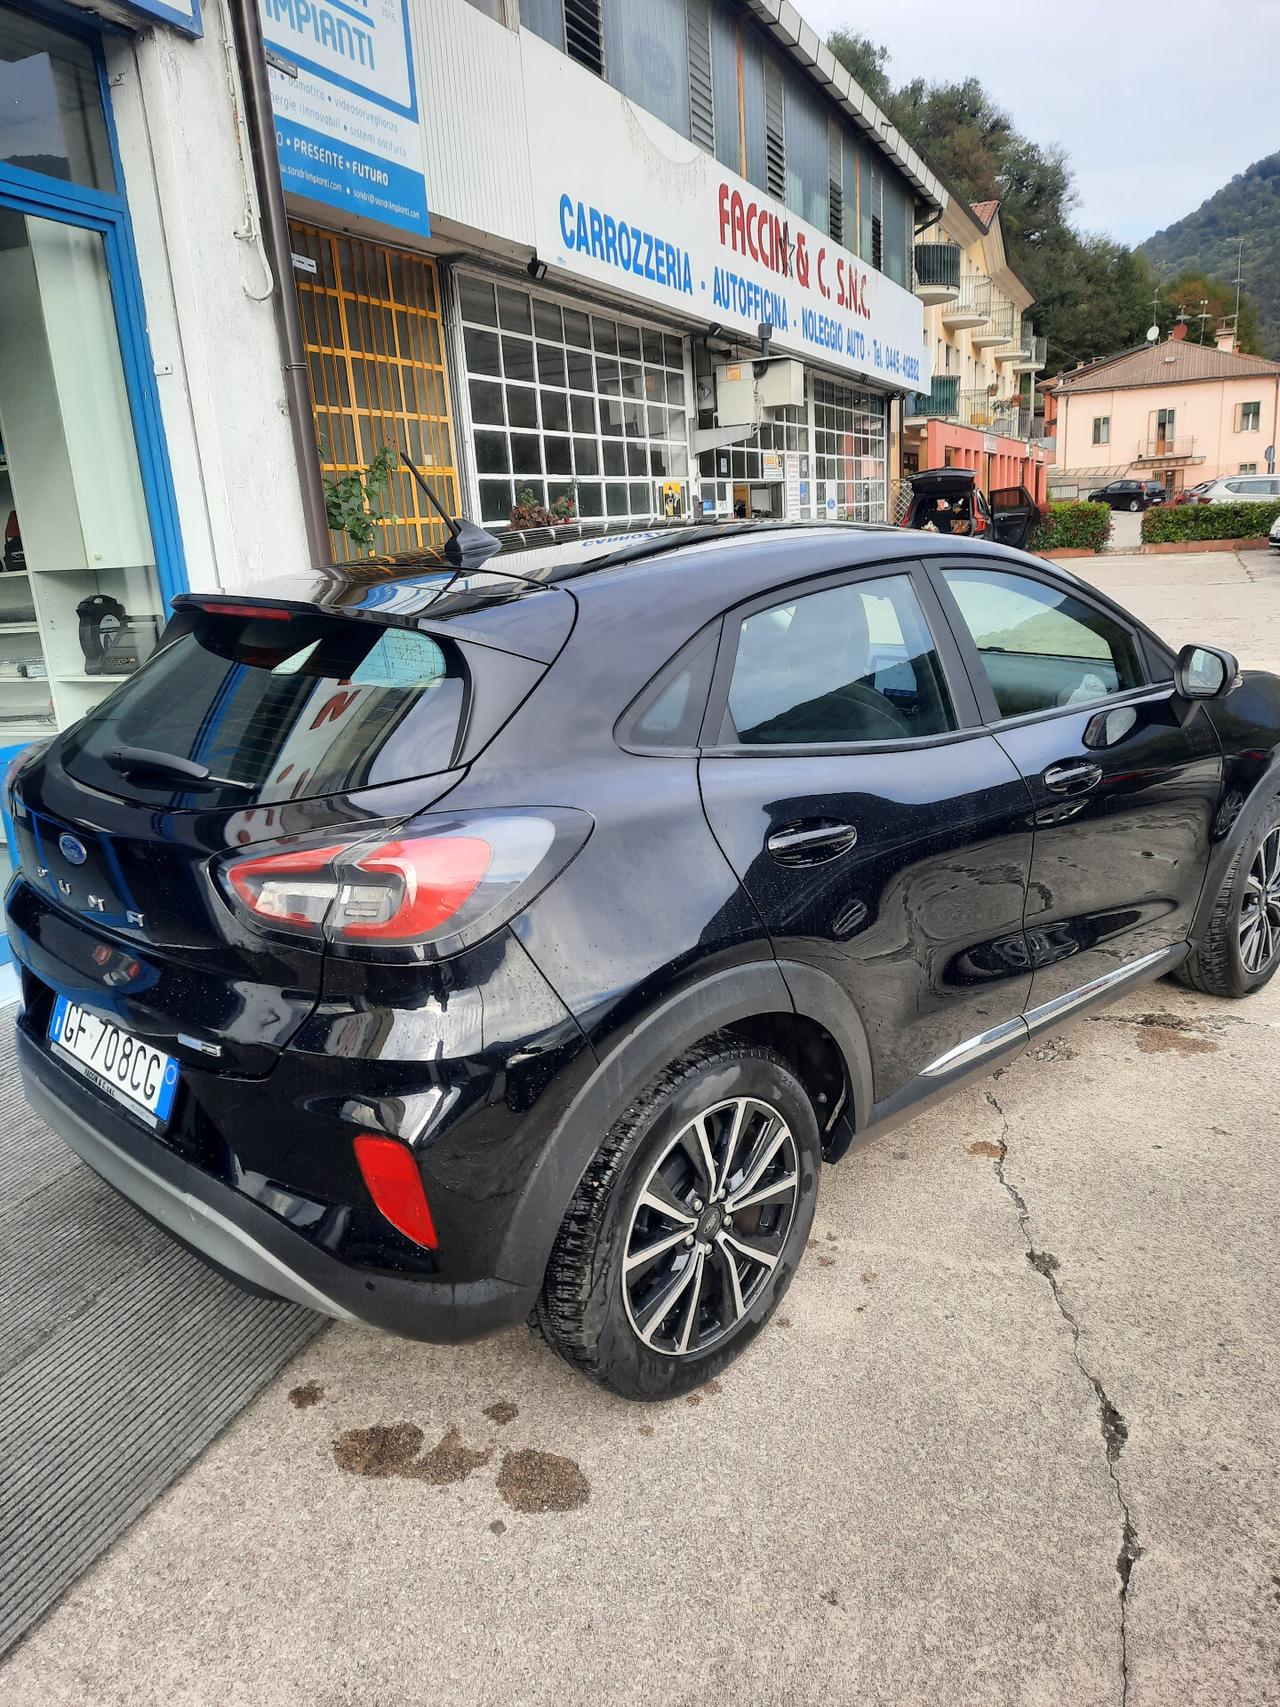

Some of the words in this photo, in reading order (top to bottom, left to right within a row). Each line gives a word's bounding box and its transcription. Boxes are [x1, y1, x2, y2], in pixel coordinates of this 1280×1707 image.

[271, 92, 297, 111] nergie
[349, 125, 376, 144] sistemi
[293, 137, 344, 170] PRESENTE
[352, 160, 389, 187] FUTURO
[560, 193, 693, 295] CARROZZERIA
[713, 266, 788, 332] AUTOFFICINA
[801, 307, 843, 353] NOLEGGIO
[847, 327, 865, 361] AUTO
[873, 339, 883, 368] Tel.
[719, 183, 788, 278] FACCIN
[796, 232, 810, 289] &
[817, 247, 831, 300] C.
[837, 258, 871, 320] S.N.C.
